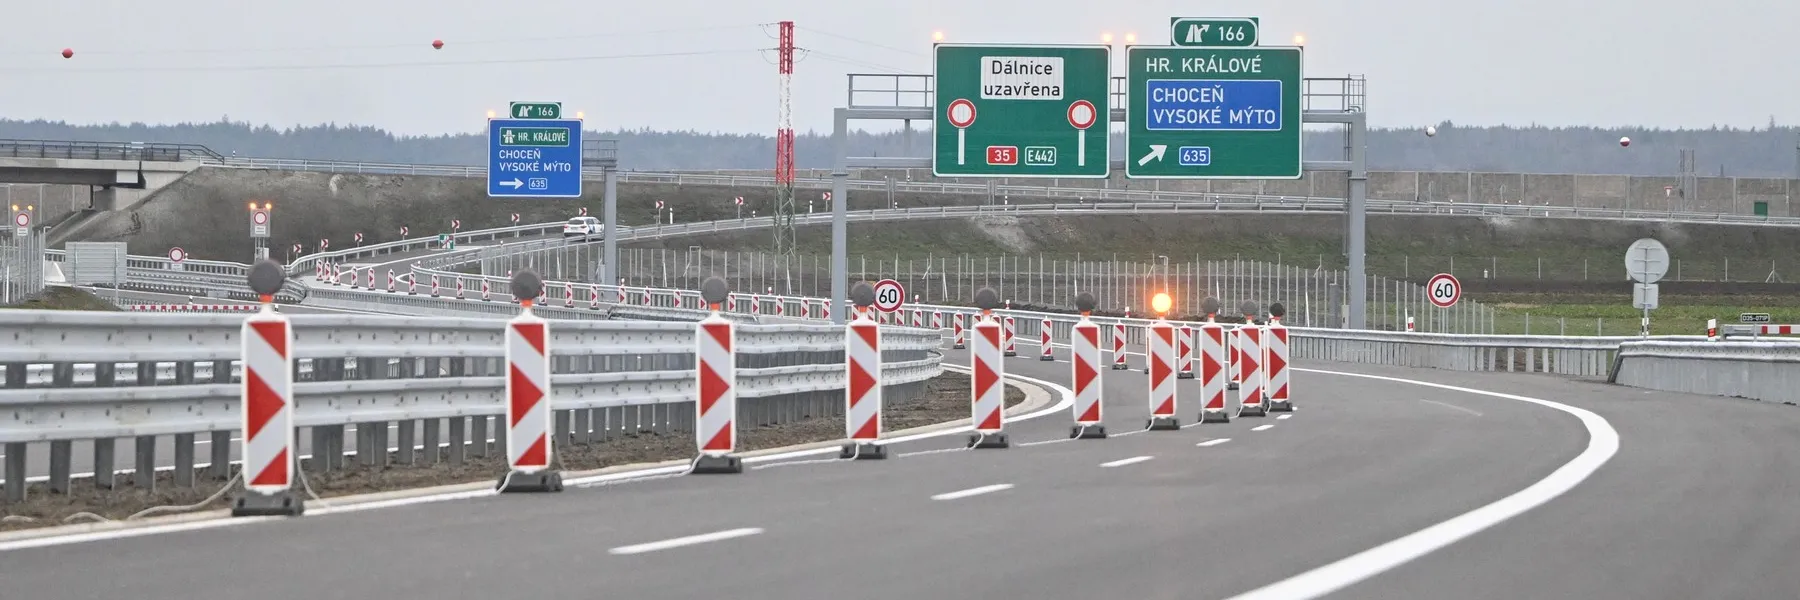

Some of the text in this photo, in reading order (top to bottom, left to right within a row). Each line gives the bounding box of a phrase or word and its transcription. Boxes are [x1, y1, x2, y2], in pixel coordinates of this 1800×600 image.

[1219, 26, 1245, 41] 166
[992, 60, 1053, 76] Dálnice
[1146, 54, 1261, 73] HR. KRÁLOVÉ
[984, 81, 1060, 97] uzavřena
[1153, 84, 1224, 103] CHOCEŇ
[538, 107, 553, 116] 166
[1153, 105, 1276, 124] VYSOKÉ MÝTO
[518, 130, 566, 142] HR. KRÁLOVÉ
[499, 148, 541, 159] CHOCEŇ
[994, 149, 1010, 162] 35
[1027, 149, 1054, 162] E442
[1183, 149, 1207, 162] 635
[499, 160, 571, 172] VYSOKÉ MÝTO
[531, 180, 545, 188] 635
[878, 289, 897, 304] 60
[1434, 283, 1453, 298] 60
